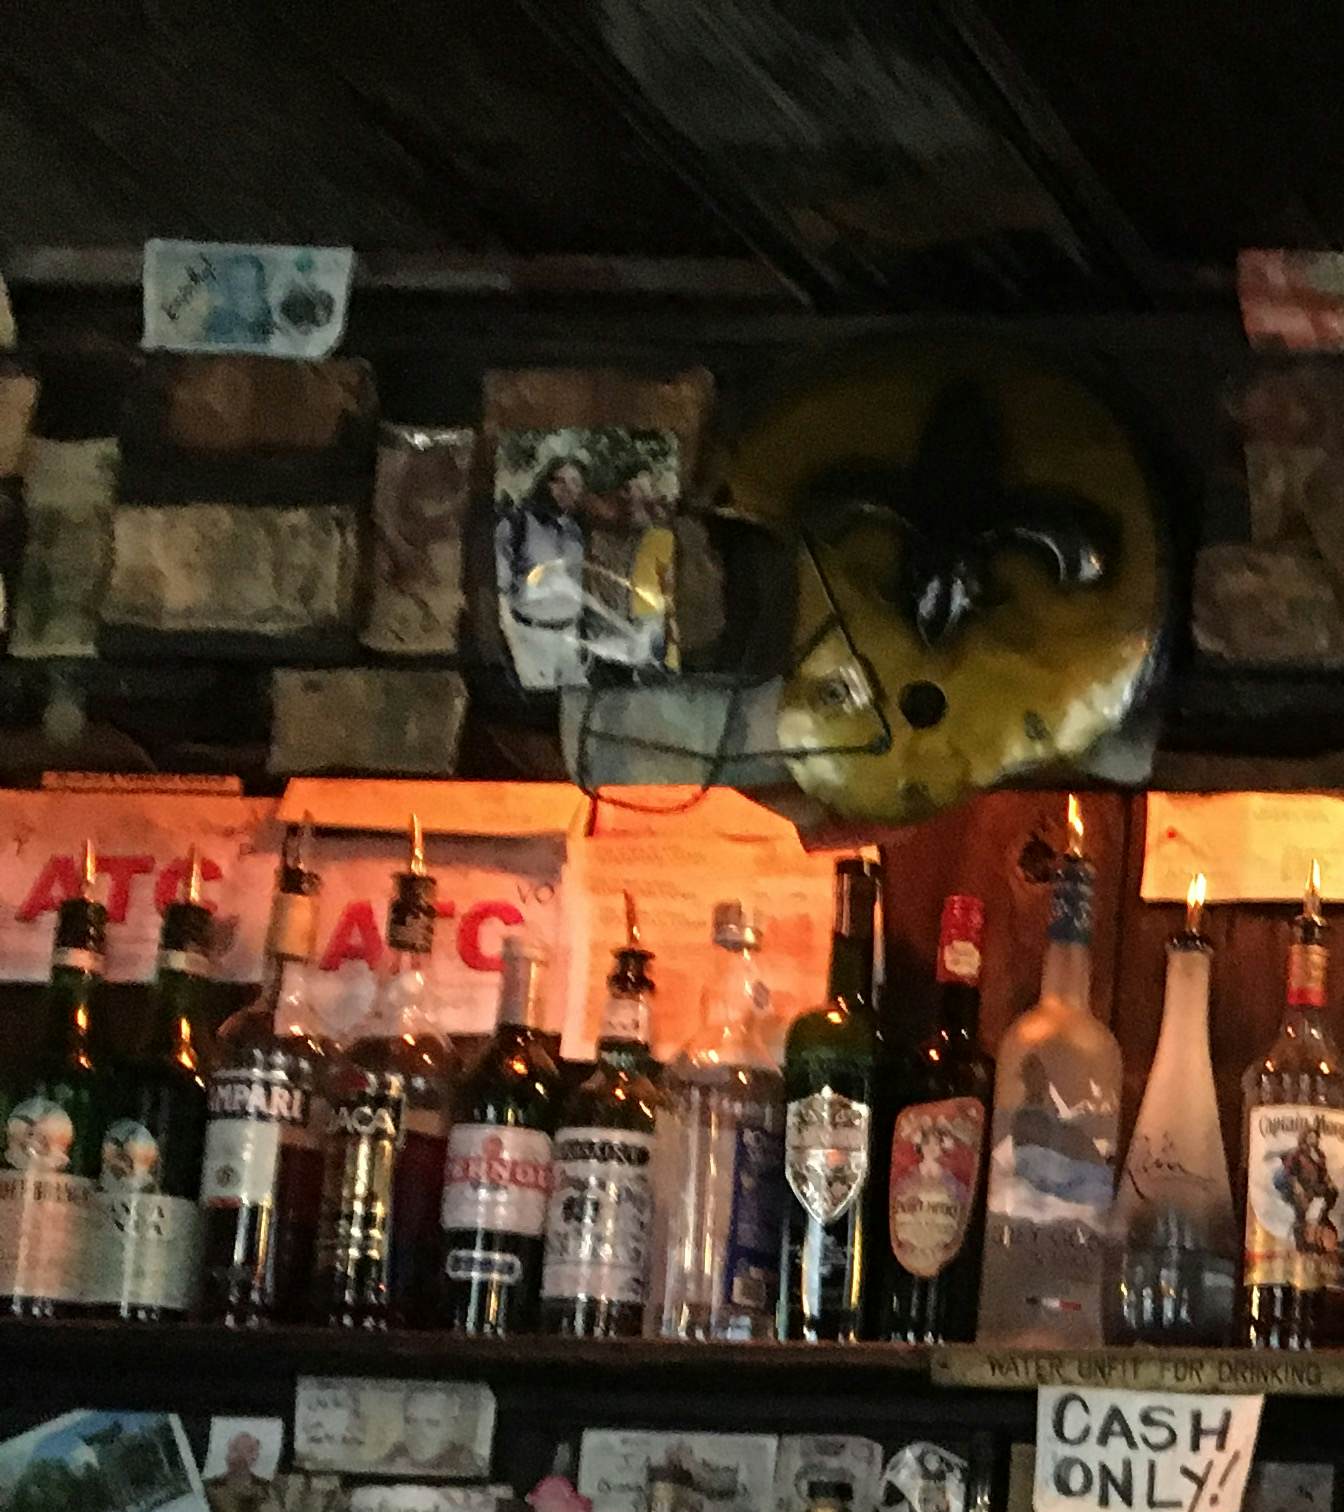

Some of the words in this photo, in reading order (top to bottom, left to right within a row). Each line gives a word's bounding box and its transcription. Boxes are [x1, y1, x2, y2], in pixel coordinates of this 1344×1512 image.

[320, 899, 524, 972] AC
[987, 1356, 1063, 1380] WATER
[1077, 1356, 1139, 1380] UNFIT
[1160, 1357, 1202, 1382] FOR
[1218, 1359, 1323, 1386] DRINKING
[1052, 1392, 1233, 1453] CASH
